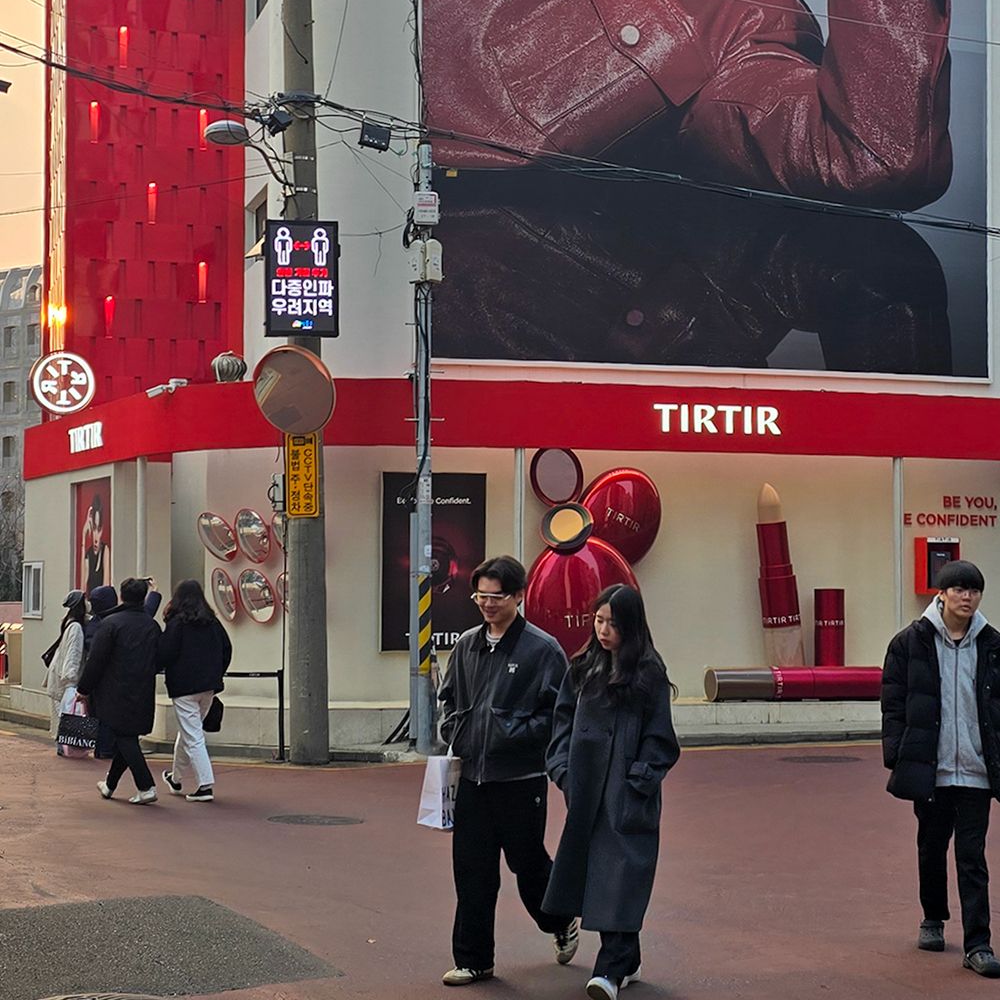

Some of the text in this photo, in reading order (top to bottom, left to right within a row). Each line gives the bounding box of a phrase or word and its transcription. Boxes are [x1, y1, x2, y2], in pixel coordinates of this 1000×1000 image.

[271, 279, 334, 297] 다중인파
[271, 298, 333, 316] 우려지역
[653, 403, 782, 435] TIRTIR
[943, 496, 998, 511] BE YOU,
[606, 507, 640, 532] TIRTIR
[904, 513, 998, 527] E CONFIDENT
